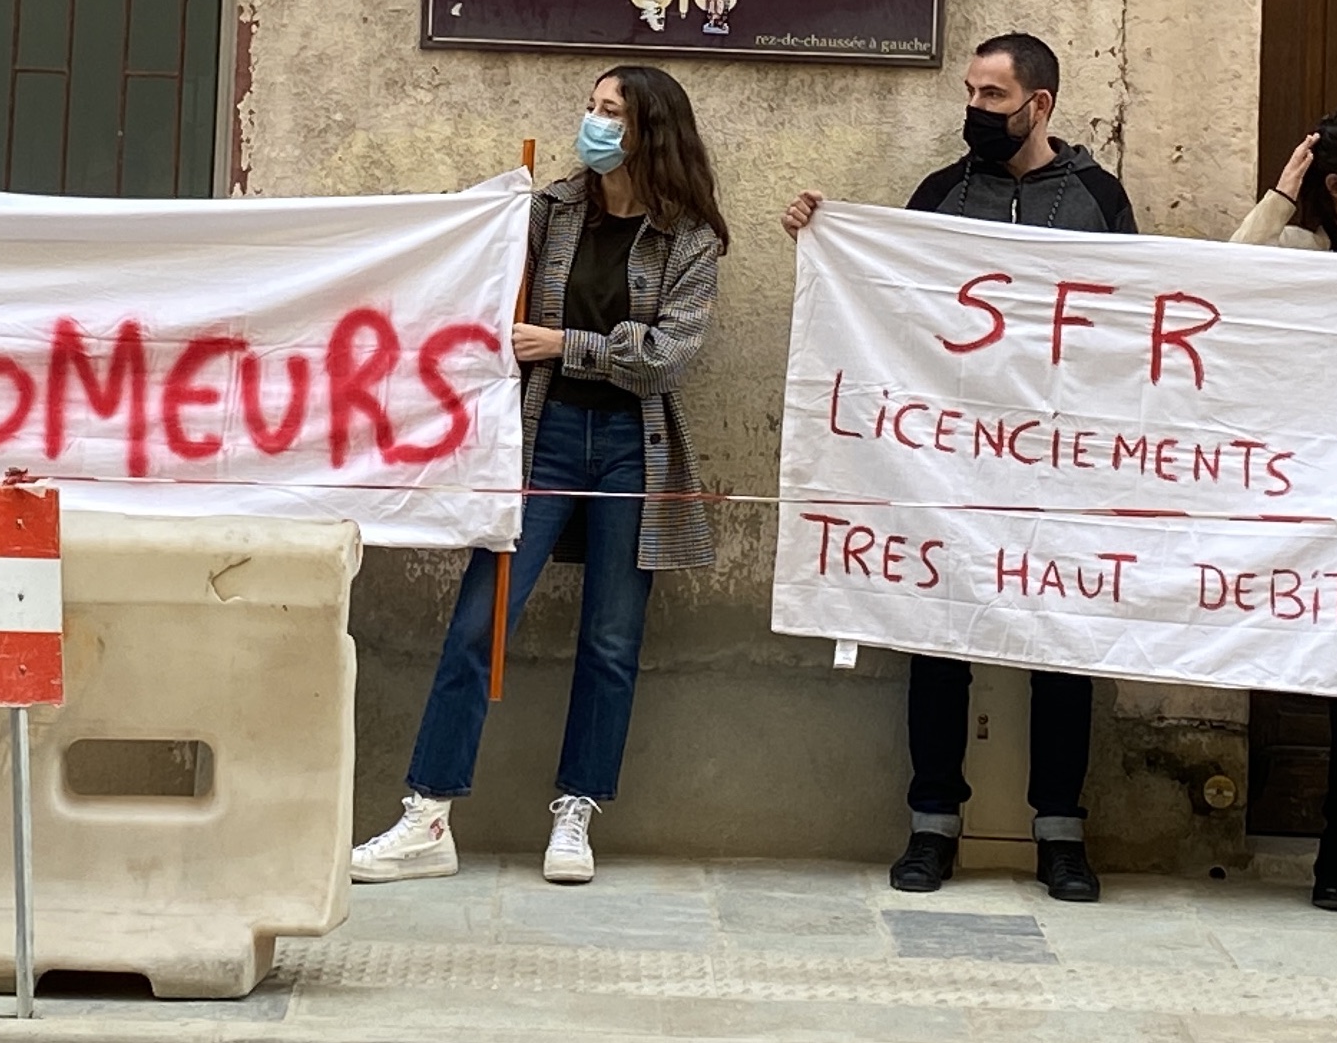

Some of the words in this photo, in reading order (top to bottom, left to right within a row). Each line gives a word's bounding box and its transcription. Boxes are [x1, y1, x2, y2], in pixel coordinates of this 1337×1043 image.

[755, 33, 867, 49] rez-de-chaussée
[869, 37, 877, 49] à
[880, 38, 932, 53] gauche
[935, 272, 1222, 391] SFR
[799, 512, 945, 589] TRES
[995, 548, 1138, 604] HAUT
